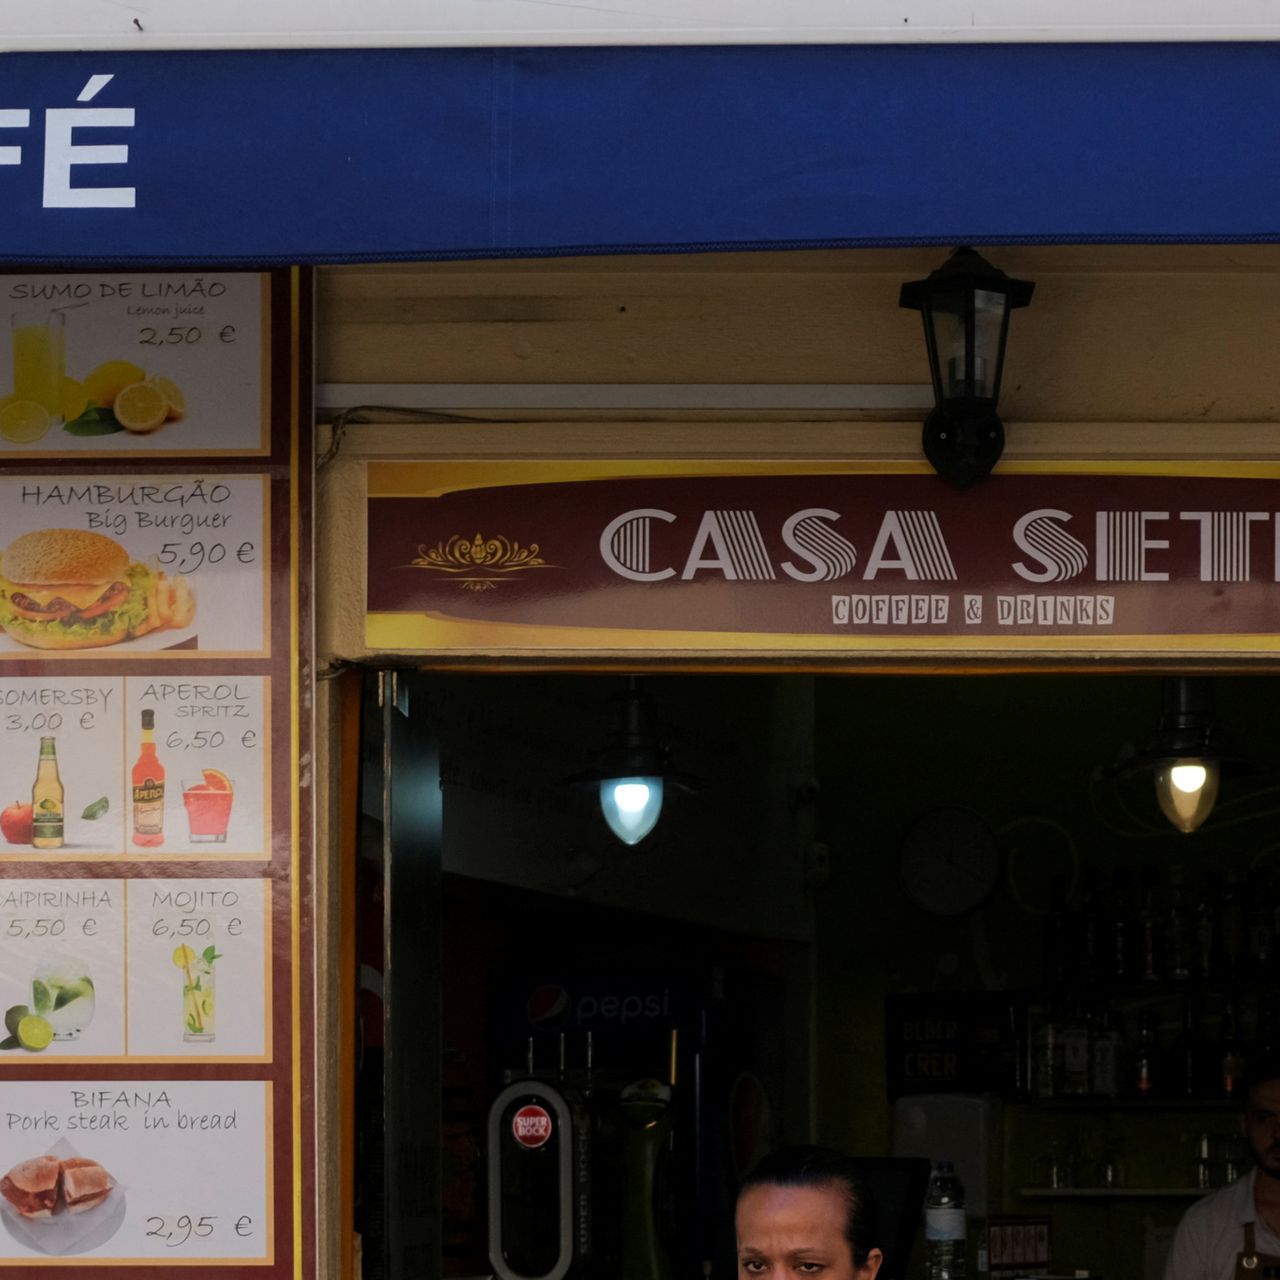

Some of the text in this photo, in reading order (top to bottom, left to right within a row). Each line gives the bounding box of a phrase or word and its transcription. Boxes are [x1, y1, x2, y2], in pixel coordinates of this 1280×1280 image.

[9, 278, 226, 300] SUMO LIMÃO
[139, 327, 201, 346] 2,50
[22, 478, 230, 507] HAMBURGÃO
[83, 509, 231, 533] Big Burguer
[600, 505, 961, 582] CASA
[158, 542, 226, 574] 5,90
[832, 595, 1114, 625] COFFEE DRINKS
[140, 684, 248, 701] APEROL
[177, 705, 249, 717] SPRITZ
[6, 712, 62, 732] 3,00
[166, 731, 224, 750] 6,50
[153, 890, 238, 913] MOJITO
[7, 919, 210, 939] 5,50 6,50
[576, 990, 673, 1025] pepsi
[71, 1091, 171, 1108] BIFANA
[6, 1110, 237, 1131] Pork steak bread
[517, 1116, 547, 1126] SUPER
[519, 1126, 546, 1136] BOCK
[146, 1215, 217, 1247] 2,95
